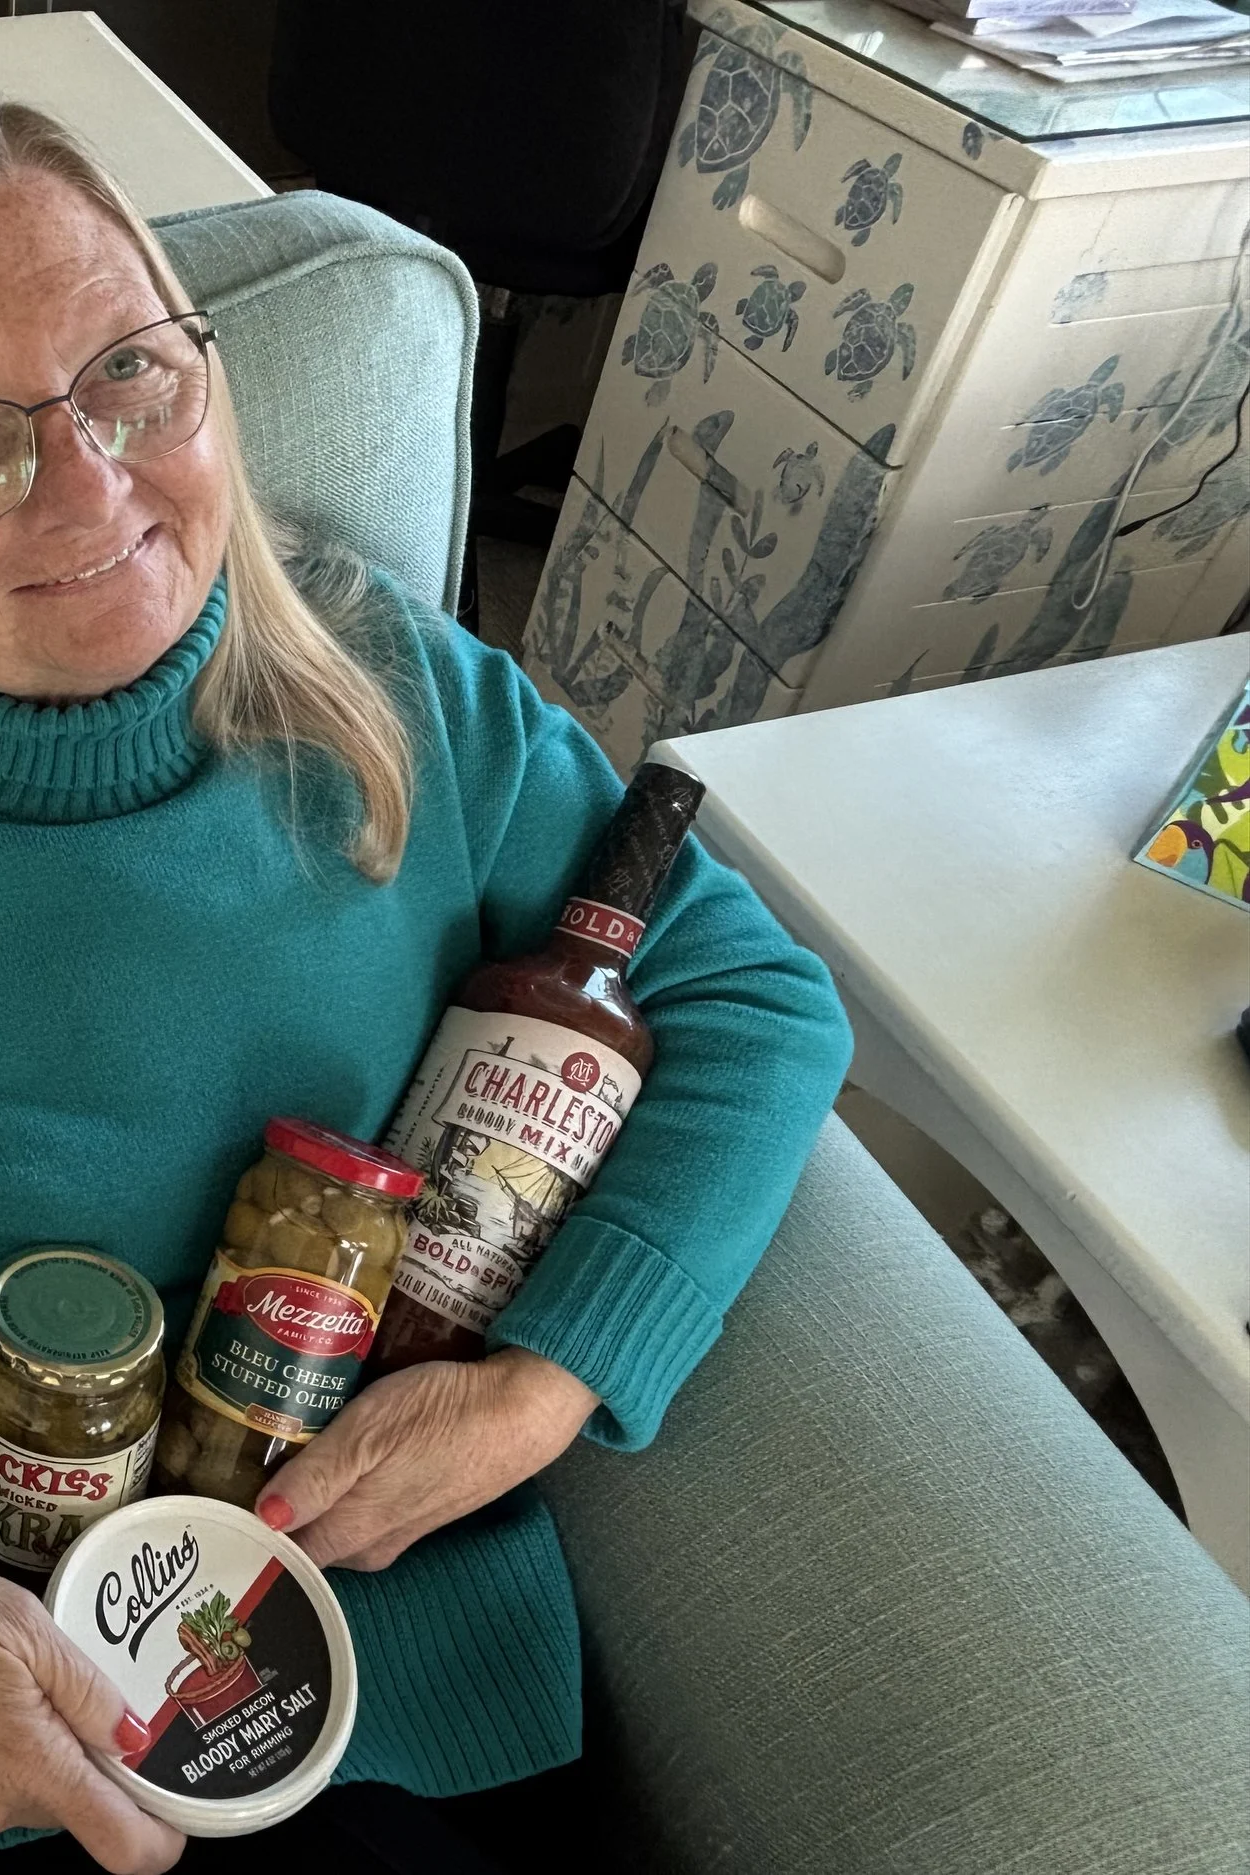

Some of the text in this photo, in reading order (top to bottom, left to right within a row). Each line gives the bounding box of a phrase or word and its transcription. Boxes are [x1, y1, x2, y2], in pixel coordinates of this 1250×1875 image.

[464, 1060, 623, 1155] CHARLESTO
[519, 1124, 573, 1164] MIX
[414, 1235, 472, 1276] BOLD
[451, 1237, 473, 1254] ALL
[247, 1290, 369, 1337] Mezzetta
[277, 1327, 315, 1344] FAMILY
[211, 1353, 291, 1400] STUFFED
[229, 1339, 347, 1391] BLEU CHEESE
[95, 1530, 200, 1652] Collins
[181, 1733, 241, 1784] BLOODY
[239, 1706, 282, 1744] MARY
[280, 1683, 318, 1718] SALT
[202, 1691, 276, 1745] SMOKED BACON
[228, 1756, 251, 1774] FOR
[250, 1725, 294, 1760] RIMMING
